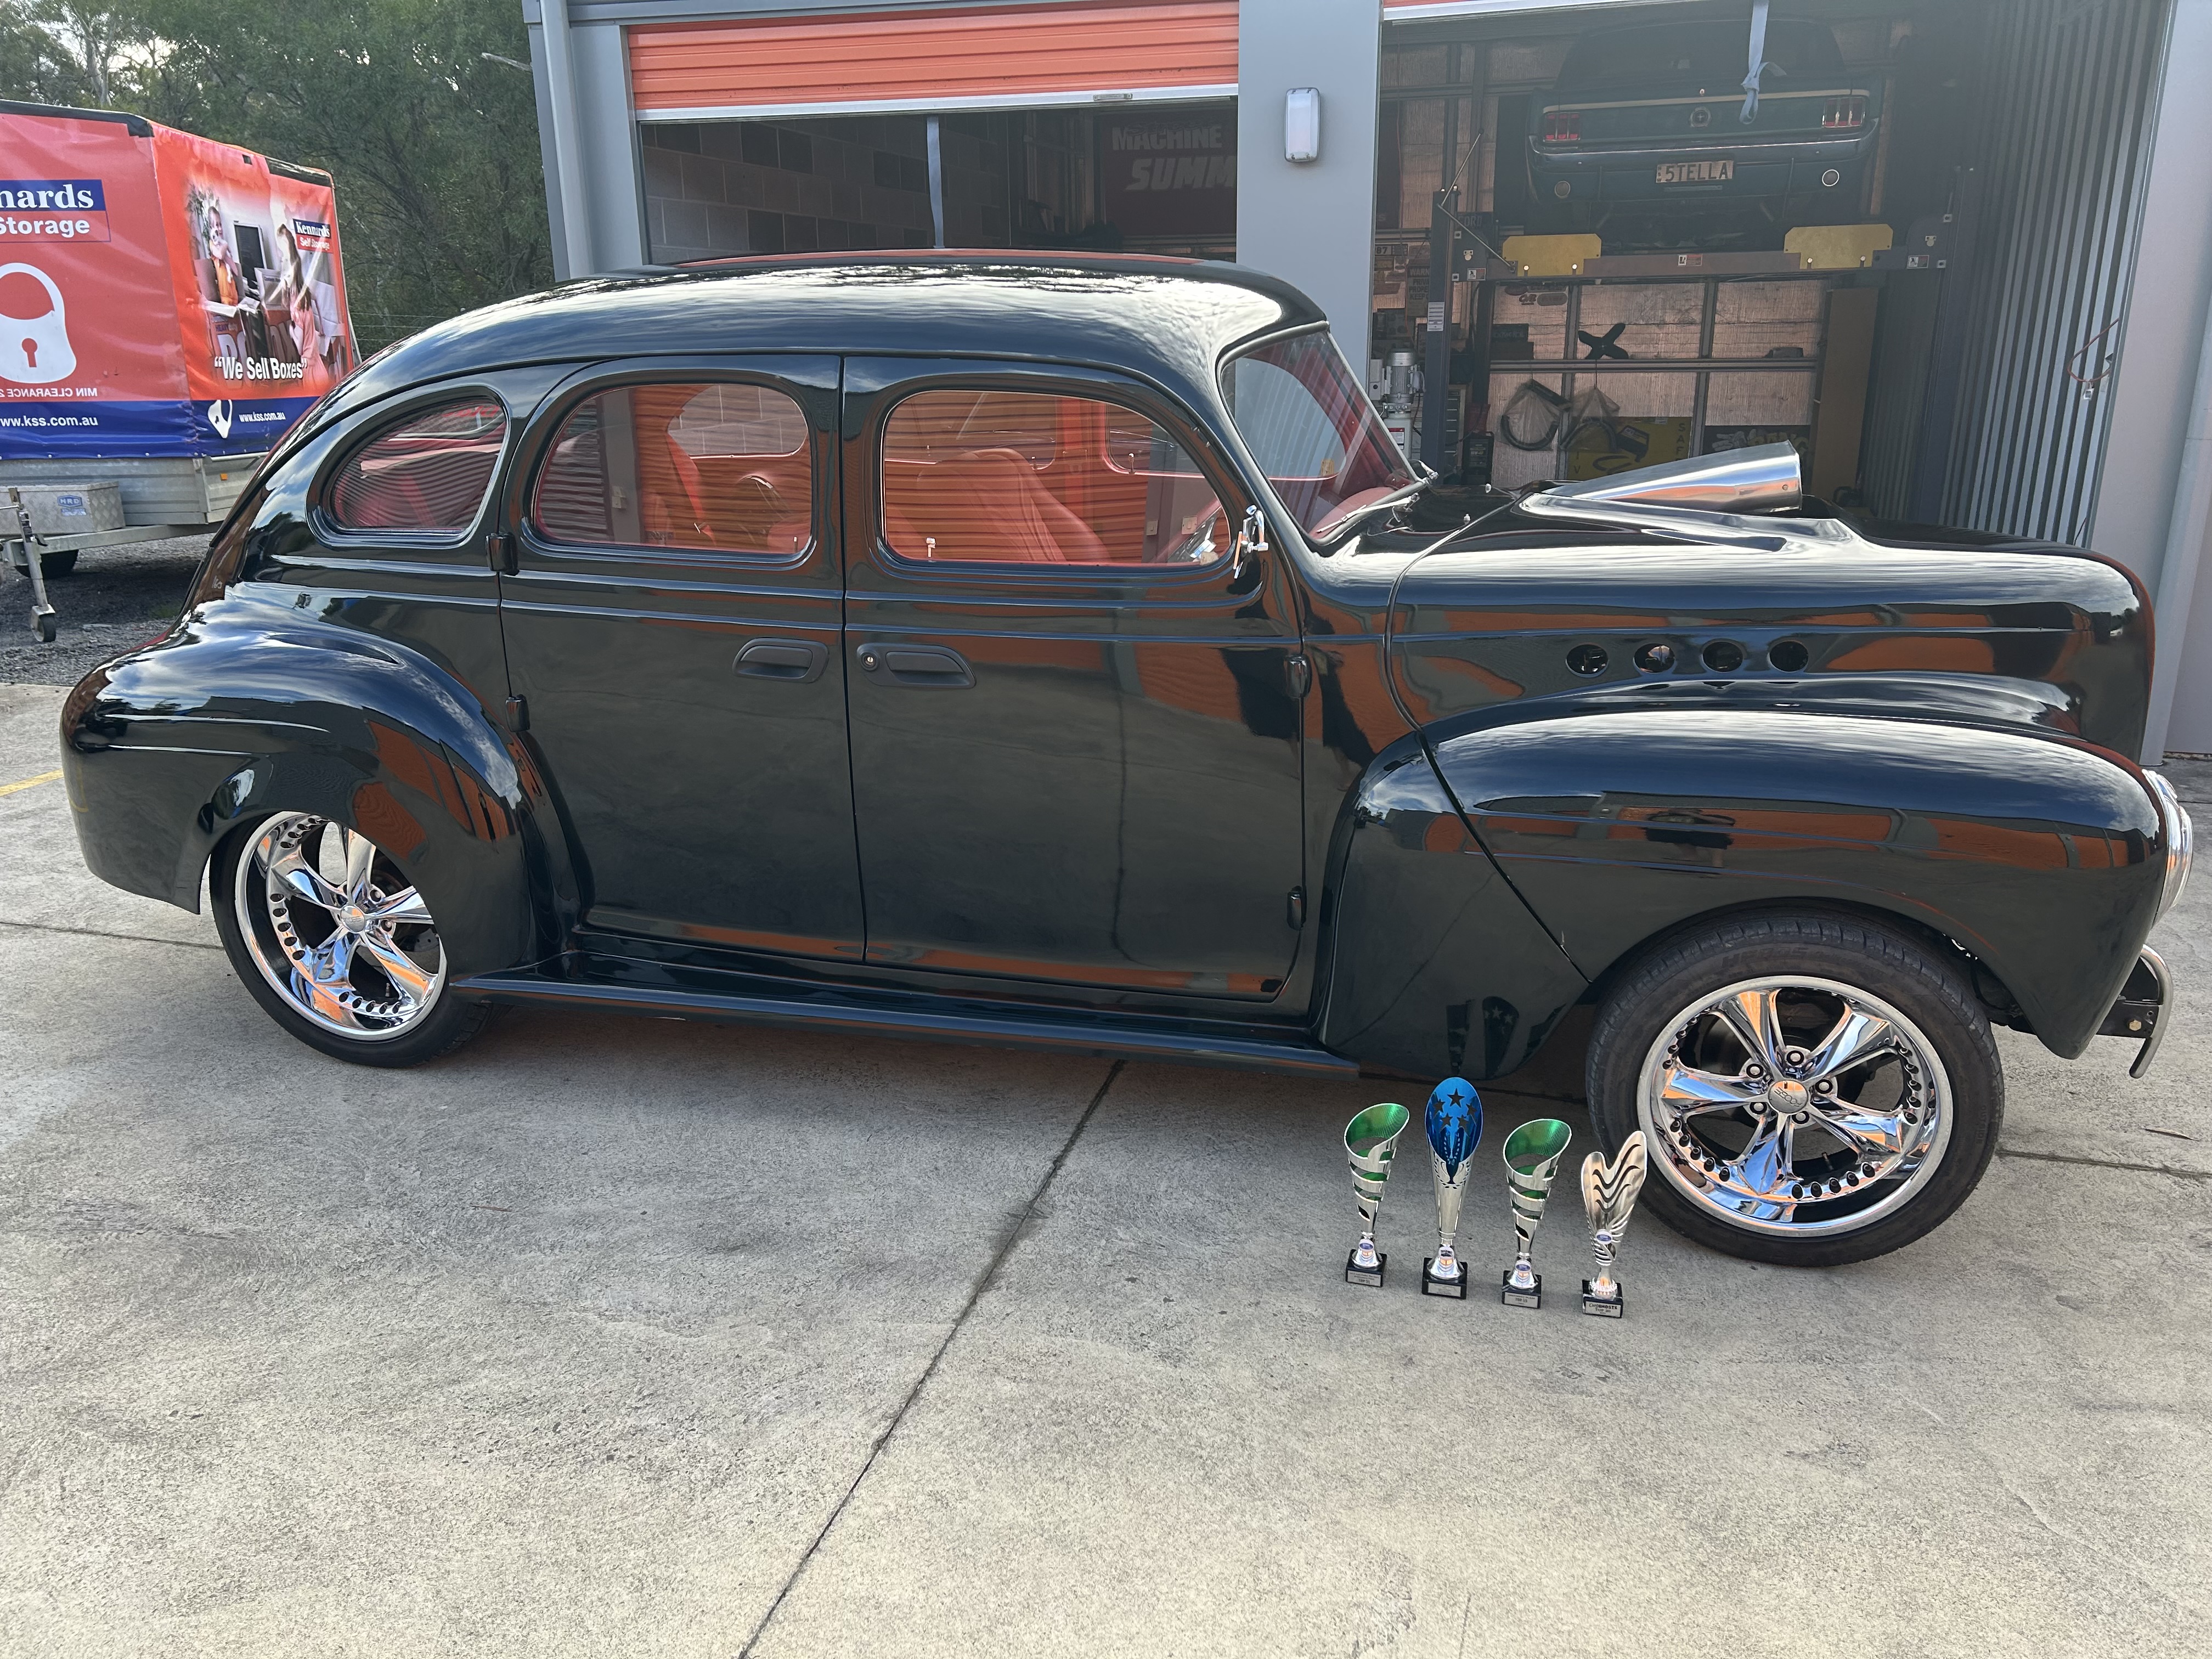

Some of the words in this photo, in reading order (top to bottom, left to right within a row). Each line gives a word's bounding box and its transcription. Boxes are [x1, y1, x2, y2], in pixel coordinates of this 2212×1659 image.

[1112, 125, 1222, 150] MACHINE
[246, 357, 270, 380] Sell
[239, 411, 286, 422] www.kss.com.au
